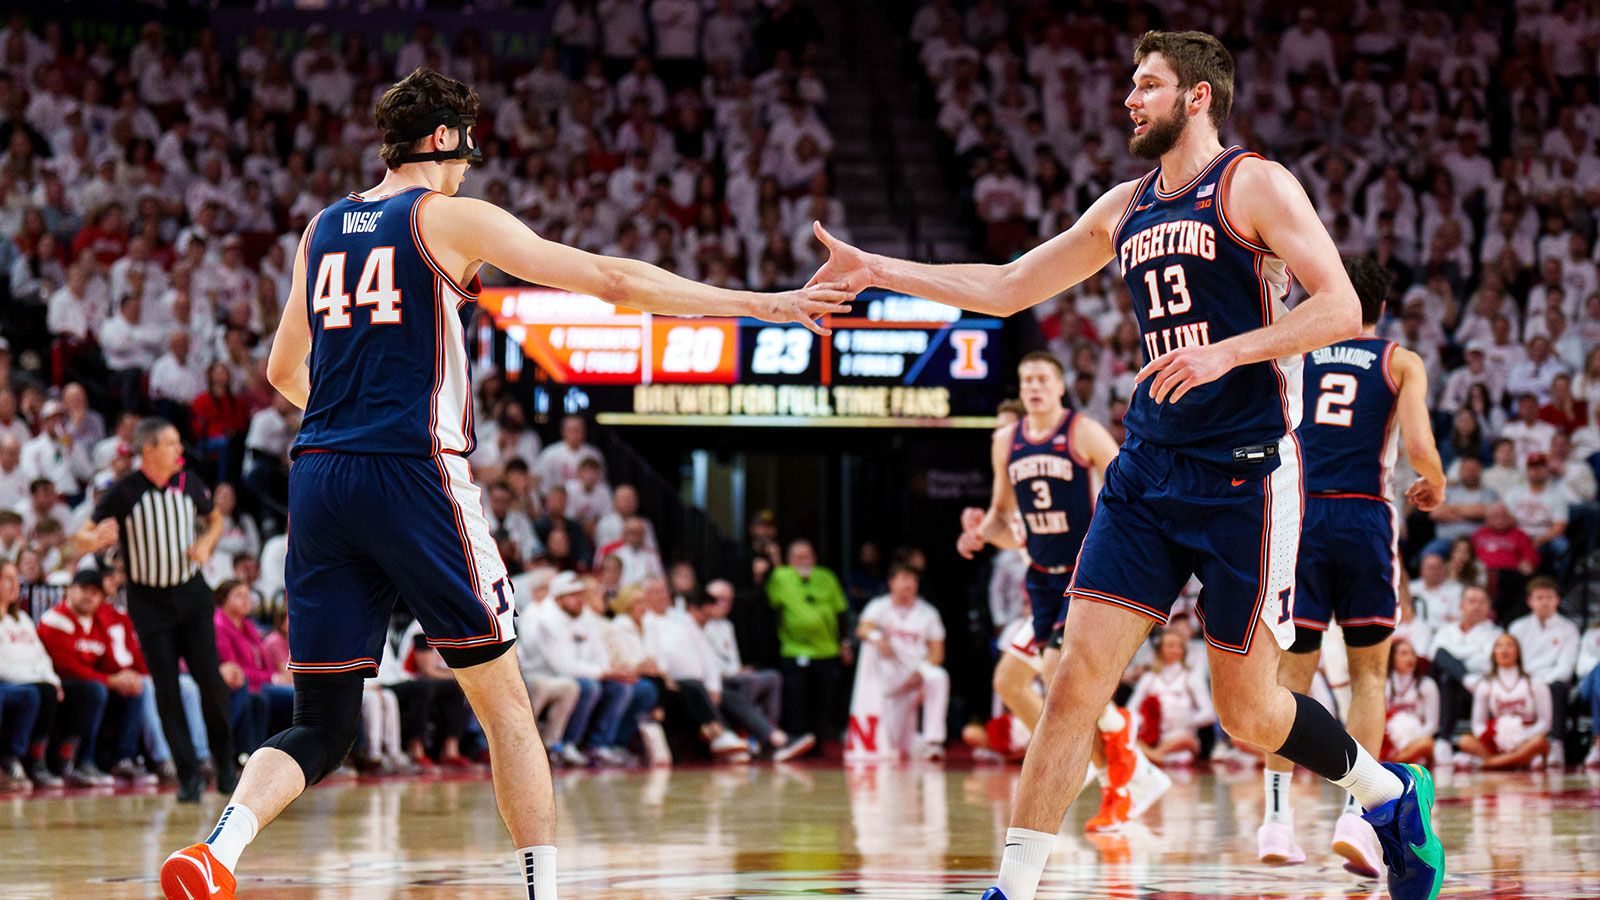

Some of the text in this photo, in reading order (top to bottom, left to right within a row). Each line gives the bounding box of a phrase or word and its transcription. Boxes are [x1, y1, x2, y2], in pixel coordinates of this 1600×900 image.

[342, 211, 383, 234] IVISIC
[1121, 220, 1216, 278] FIGHTING
[313, 246, 402, 330] 44
[1144, 264, 1192, 320] 13
[662, 326, 724, 373] 20
[751, 327, 813, 374] 23
[1315, 372, 1358, 427] 2
[1008, 453, 1074, 486] FIGHTING
[1031, 480, 1052, 510] 3
[1025, 510, 1070, 535] ILLINI
[846, 714, 879, 753] N
